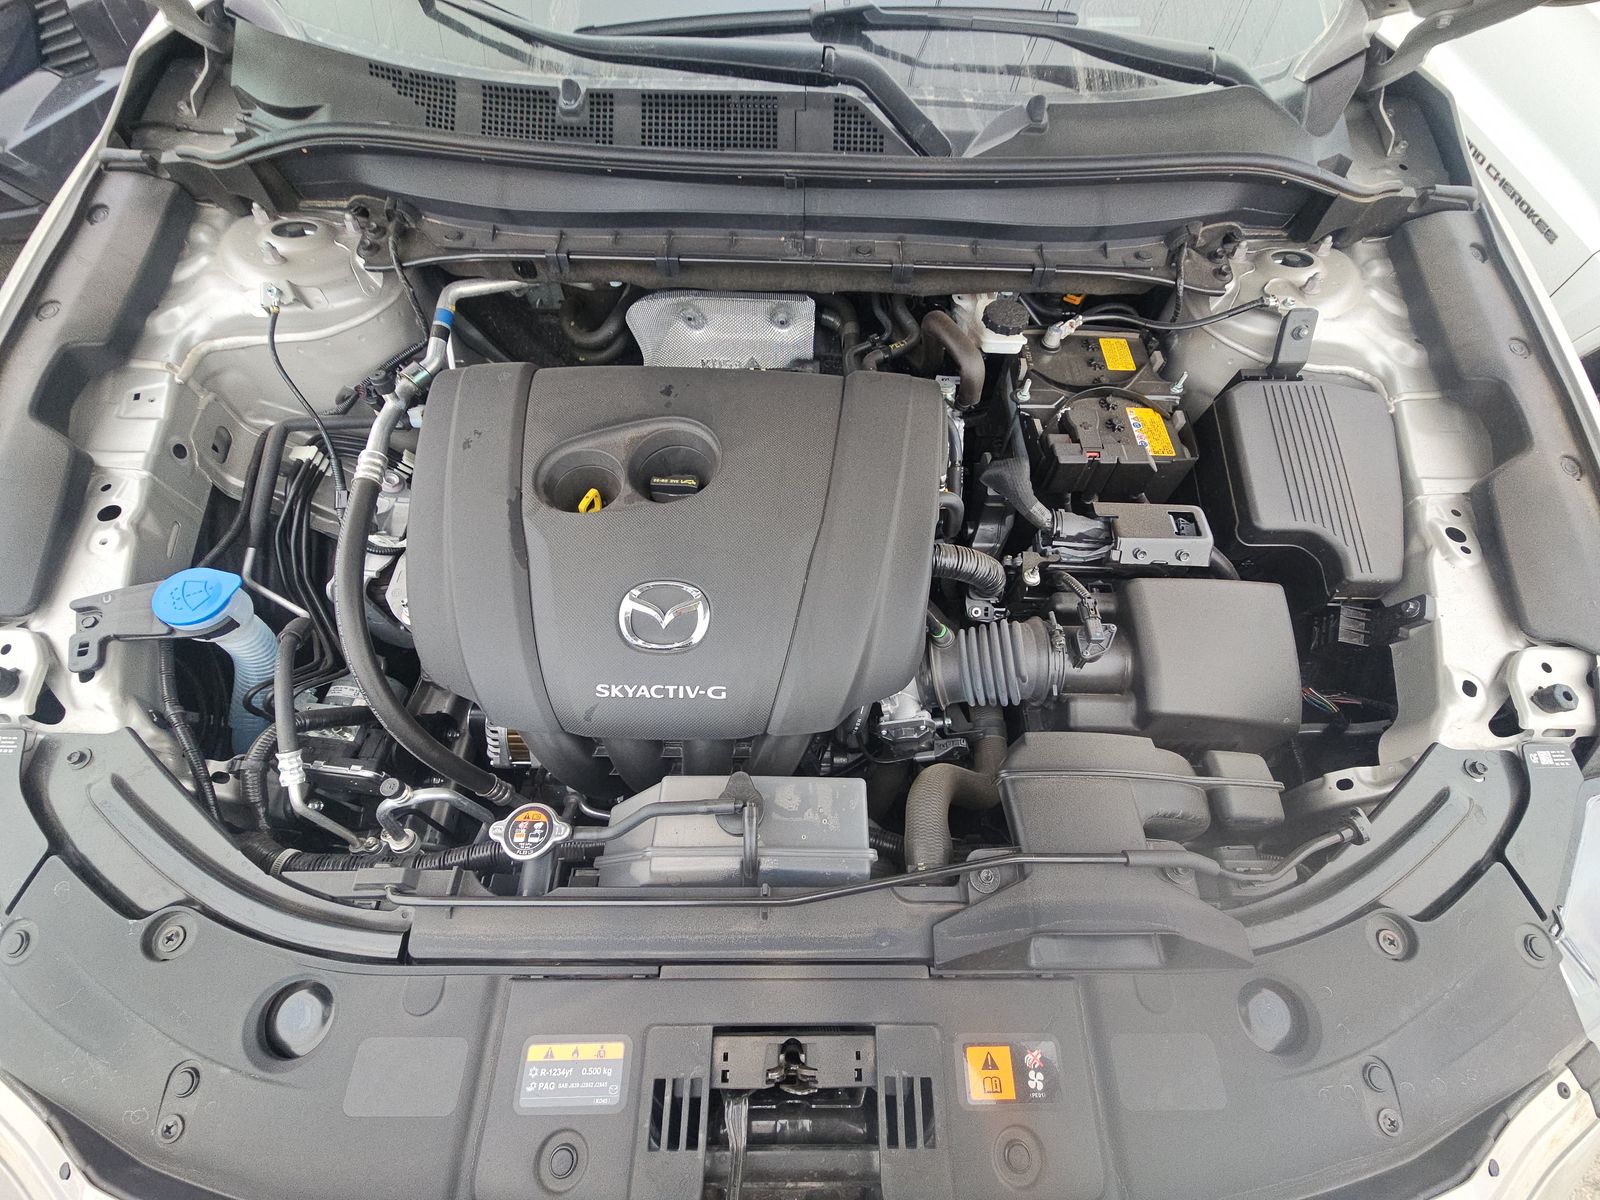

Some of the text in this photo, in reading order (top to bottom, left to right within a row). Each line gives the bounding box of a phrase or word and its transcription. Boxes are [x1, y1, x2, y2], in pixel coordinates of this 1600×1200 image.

[1485, 163, 1558, 245] CHEROKEE
[595, 683, 727, 699] SKYACTIV-G
[540, 1066, 613, 1078] R-1234yf 0.500 kg
[538, 1081, 556, 1091] PAG
